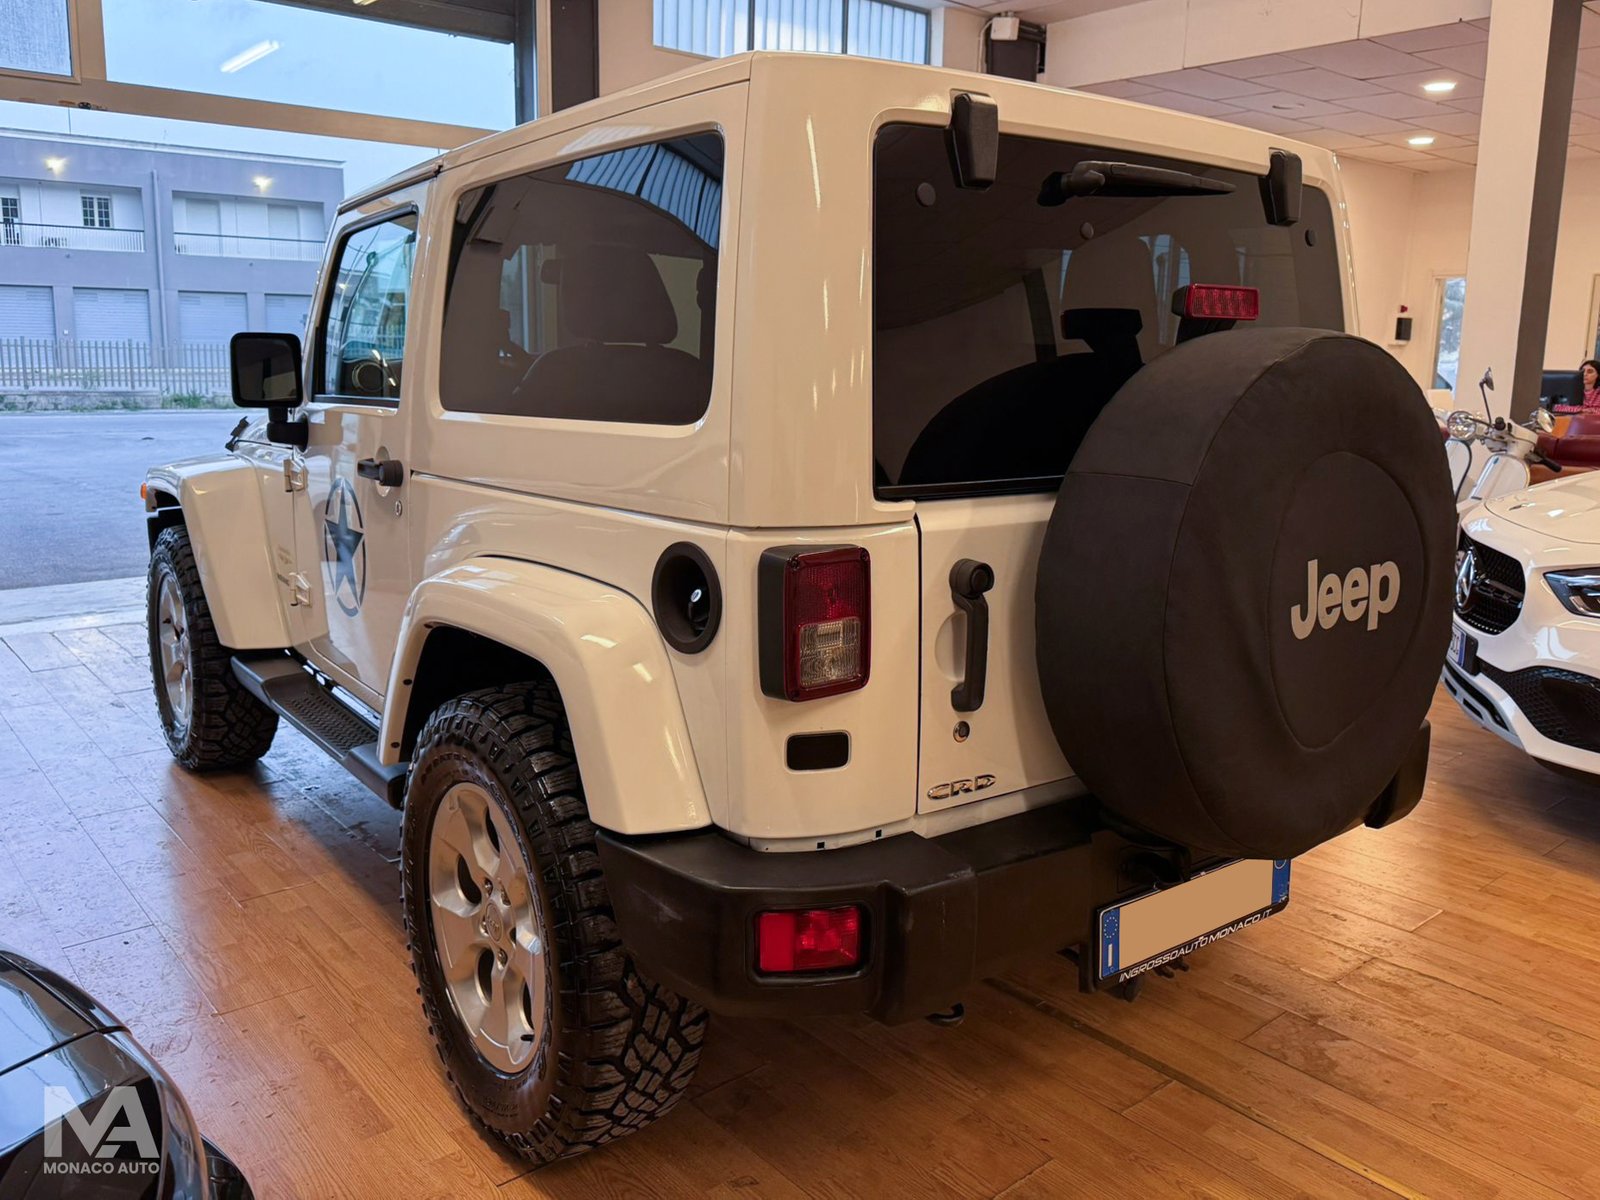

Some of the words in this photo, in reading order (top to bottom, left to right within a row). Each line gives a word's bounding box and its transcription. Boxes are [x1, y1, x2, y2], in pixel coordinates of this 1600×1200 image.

[1291, 559, 1400, 640] Jeep
[927, 774, 996, 800] CRD
[1118, 908, 1273, 983] INGROSSOAUTOMONACO.IT
